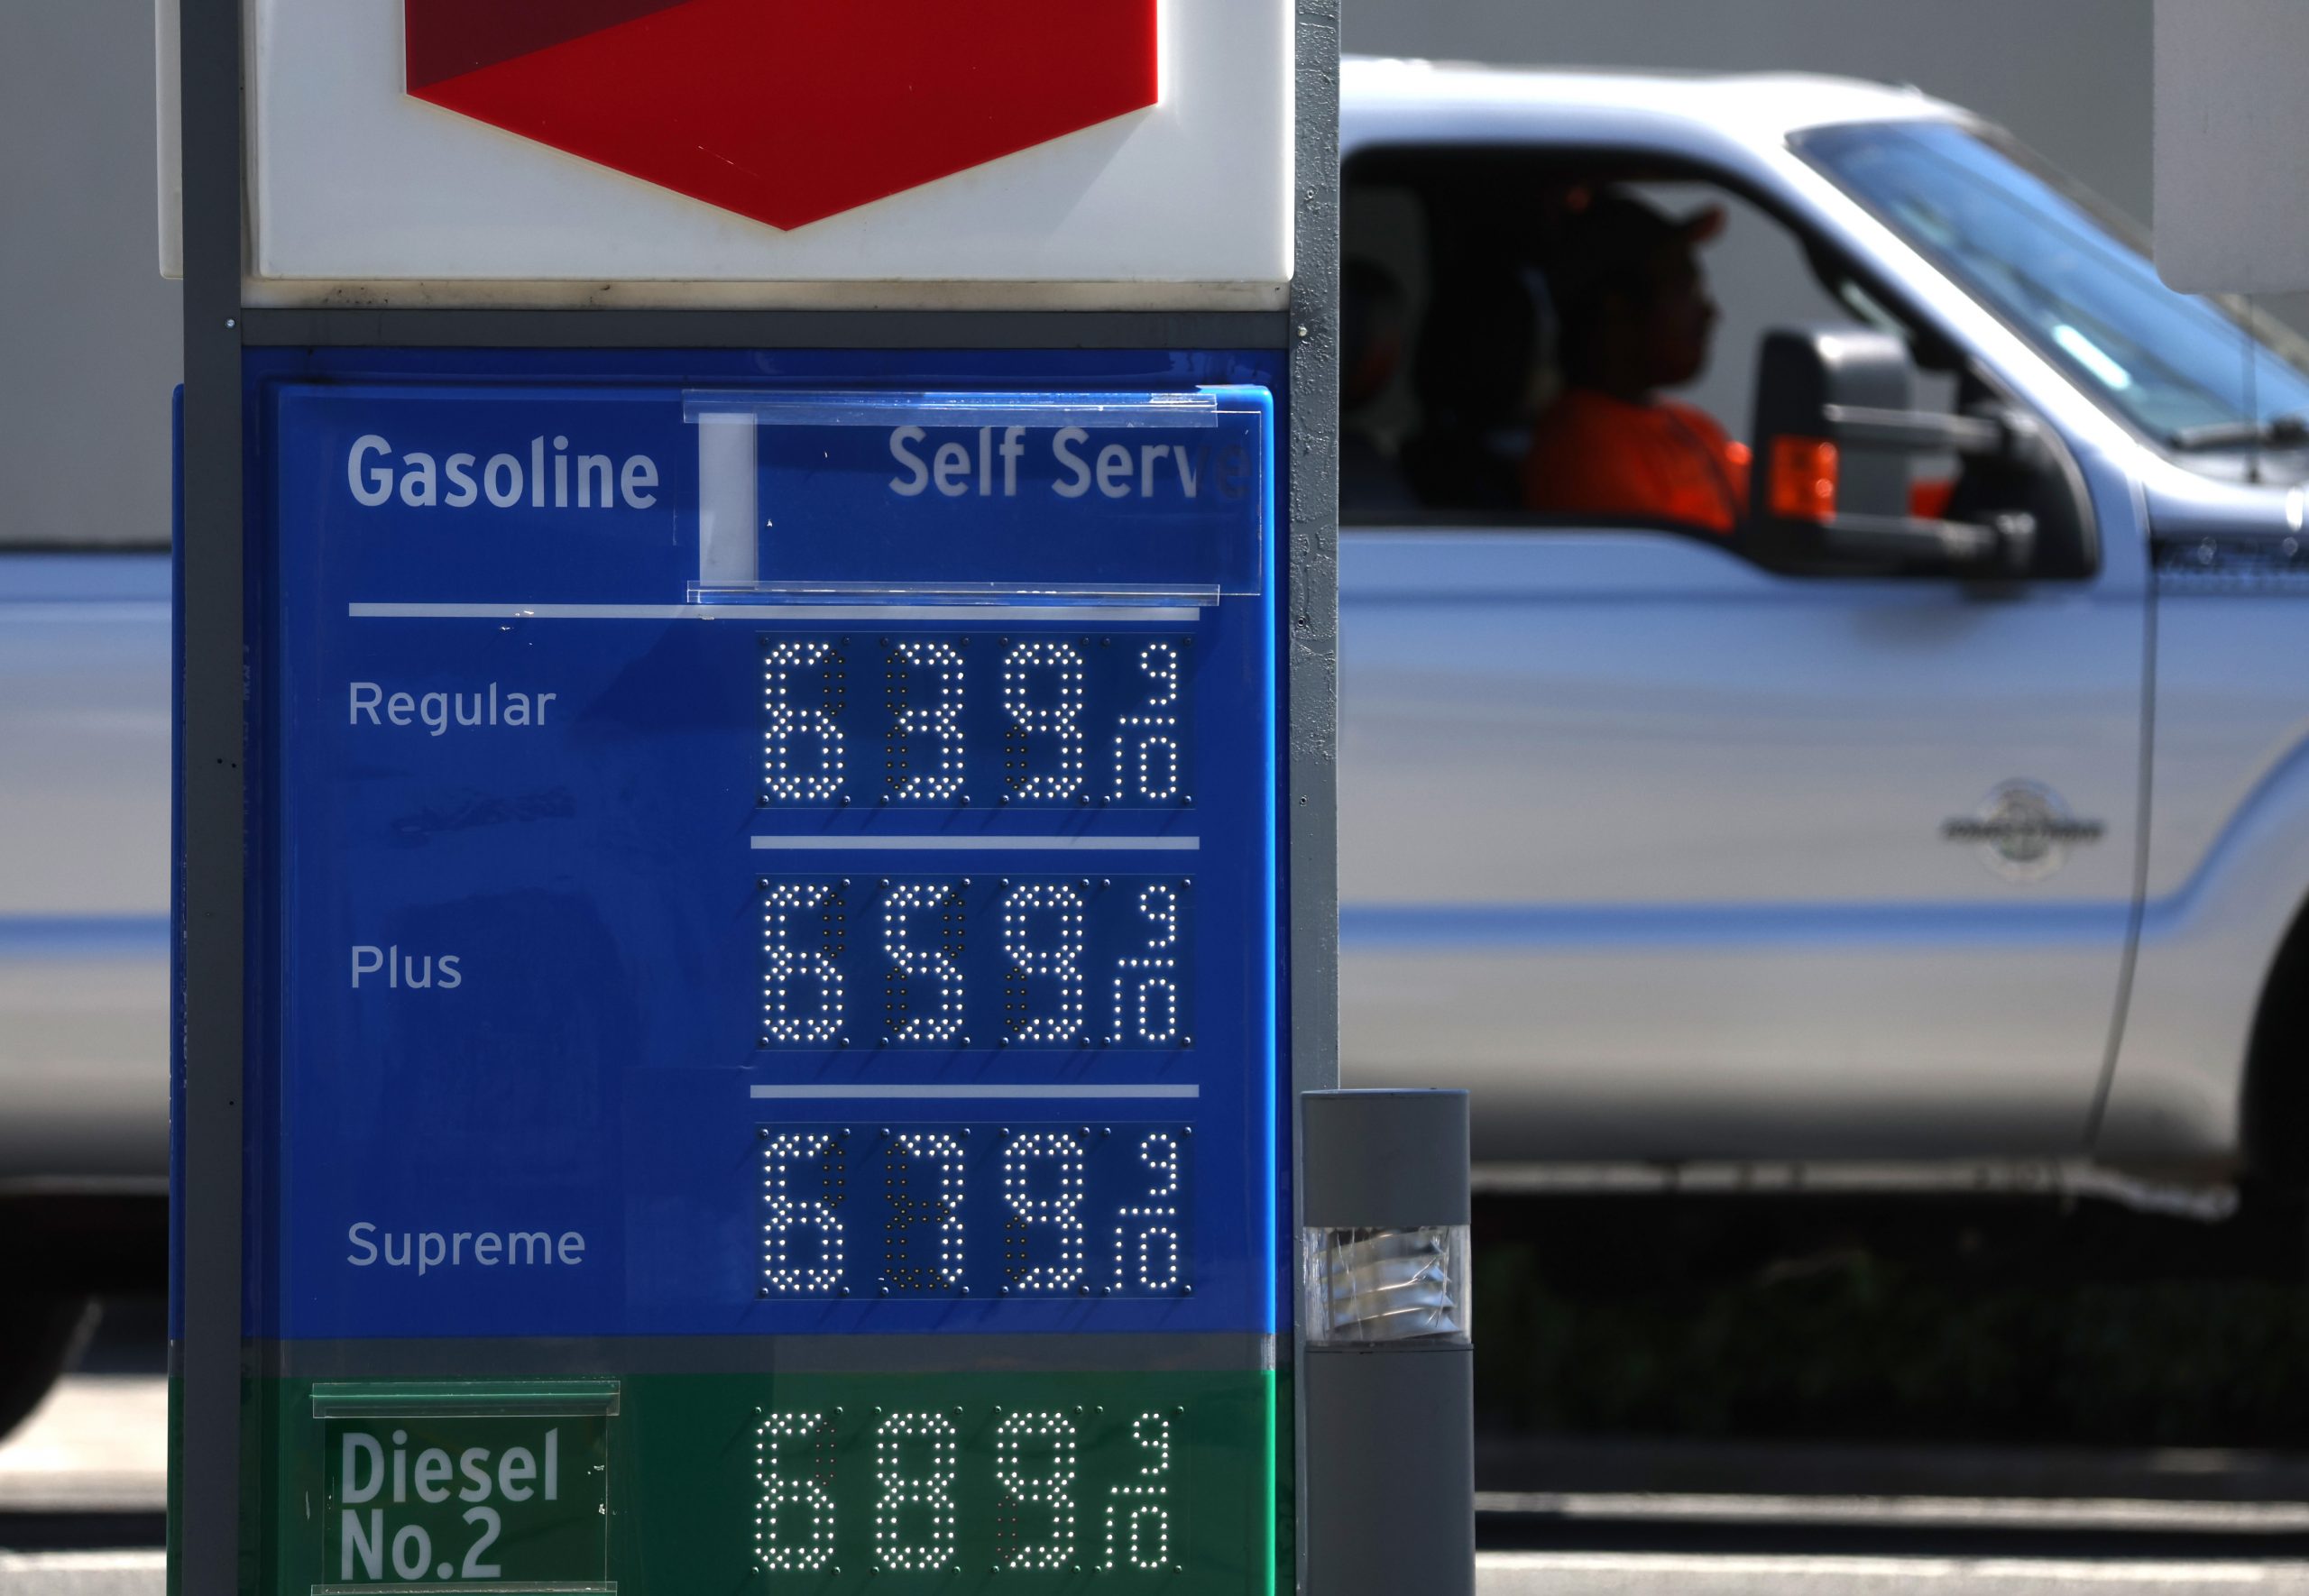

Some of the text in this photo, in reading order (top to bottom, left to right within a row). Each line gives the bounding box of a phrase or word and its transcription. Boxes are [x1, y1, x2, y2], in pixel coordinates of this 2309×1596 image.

[347, 434, 659, 509] Gasoline
[888, 425, 1252, 500] Self Serve
[349, 681, 557, 737] Regular
[764, 643, 1083, 799] 639
[352, 944, 463, 989] Plus
[764, 885, 1083, 1041] 659
[347, 1221, 585, 1277] Supreme
[764, 1134, 1083, 1290] 679
[341, 1426, 559, 1504] Diesel
[754, 1412, 1076, 1570] 689
[340, 1505, 502, 1582] No.2
